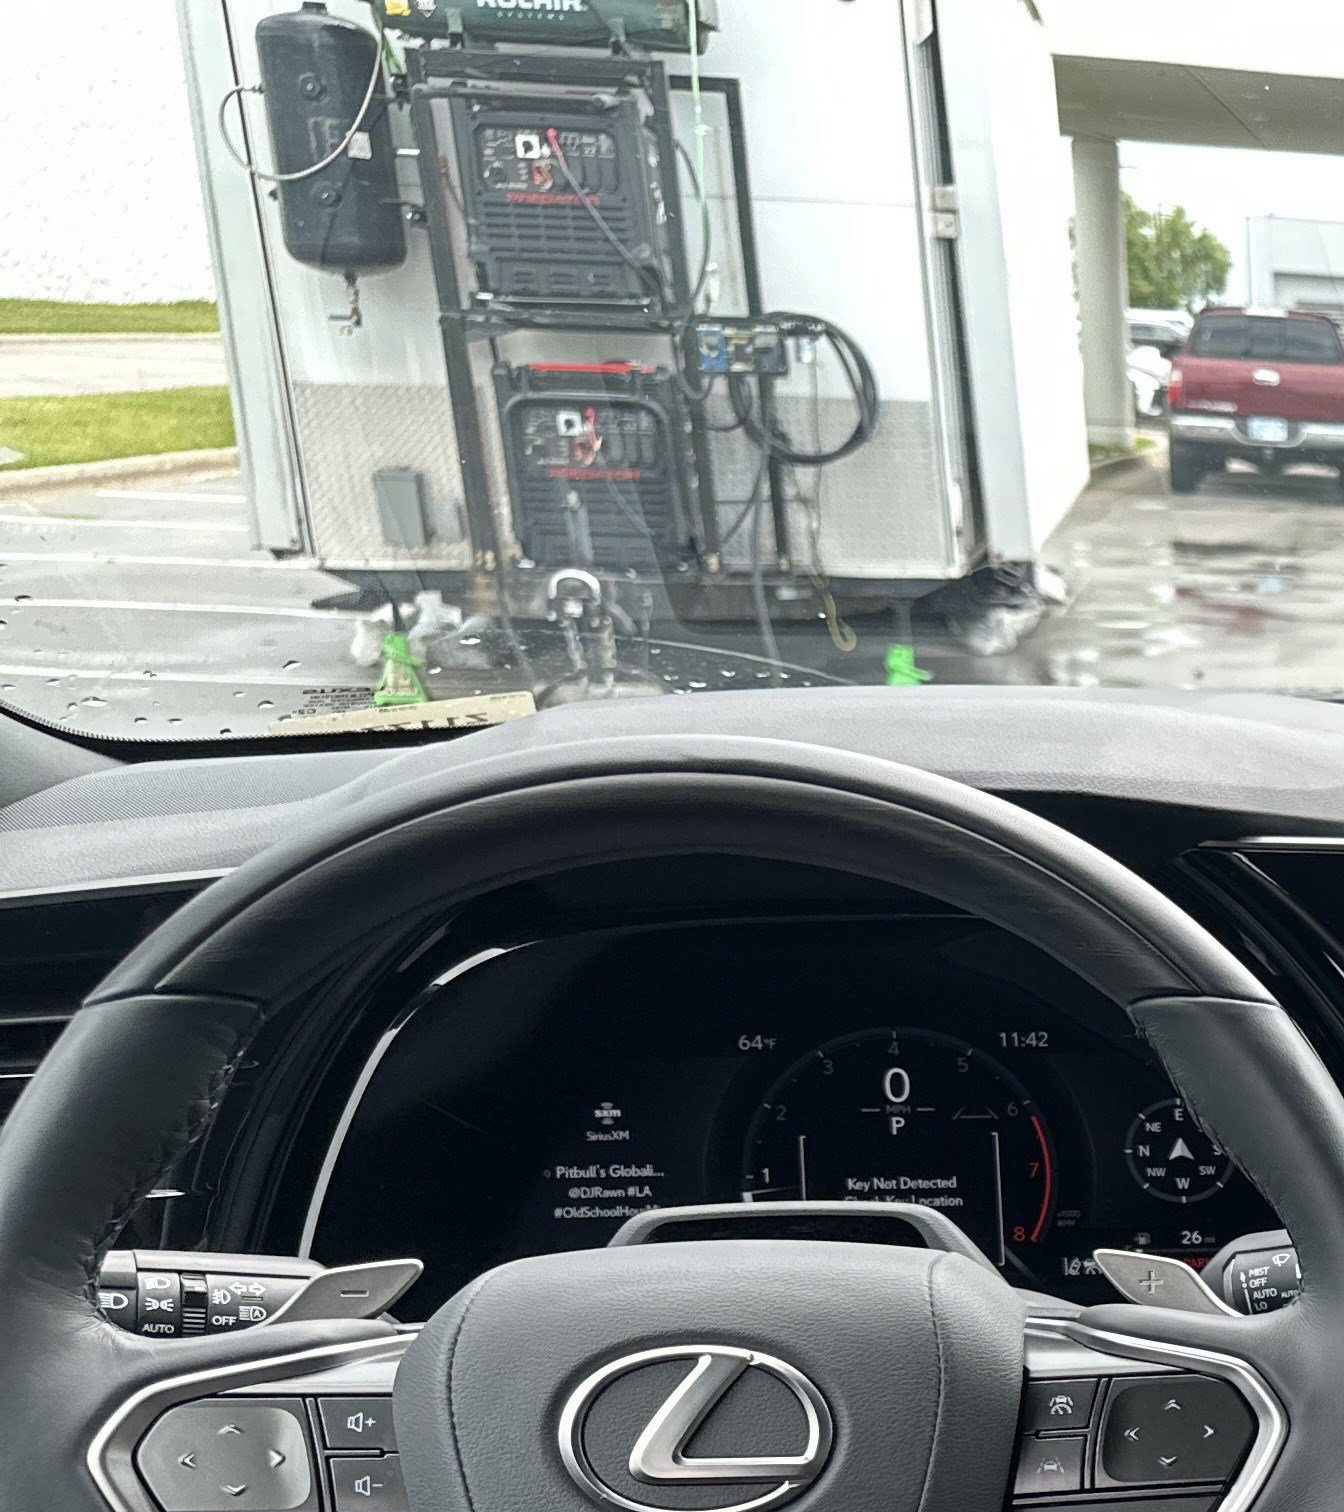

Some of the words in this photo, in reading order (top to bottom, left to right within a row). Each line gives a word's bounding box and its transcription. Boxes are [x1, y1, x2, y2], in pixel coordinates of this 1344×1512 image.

[1000, 1031, 1050, 1048] 11:42
[889, 1042, 899, 1055] 4
[822, 1060, 834, 1075] 3
[957, 1057, 969, 1073] 5
[884, 1067, 911, 1103] 0
[776, 1106, 787, 1121] 2
[1008, 1103, 1019, 1117] 6
[1174, 1108, 1184, 1122] E
[891, 1117, 905, 1135] P
[1145, 1121, 1162, 1133] NE
[1138, 1145, 1150, 1157] N
[556, 1165, 606, 1179] Pitbull's
[761, 1167, 771, 1184] 1
[1029, 1162, 1039, 1178] 7
[1146, 1167, 1167, 1177] NW
[1198, 1166, 1217, 1176] SW
[847, 1177, 870, 1193] Key
[873, 1176, 897, 1190] Not
[900, 1175, 957, 1190] Detected
[1175, 1177, 1190, 1190] W
[627, 1185, 653, 1198] #LA
[1013, 1226, 1025, 1242] 8
[1181, 1230, 1202, 1245] 26
[1248, 1265, 1270, 1278] MIST
[1249, 1277, 1268, 1289] OFF
[1253, 1287, 1278, 1300] AUTO
[212, 1315, 237, 1327] OFF
[142, 1322, 175, 1335] AUTO
